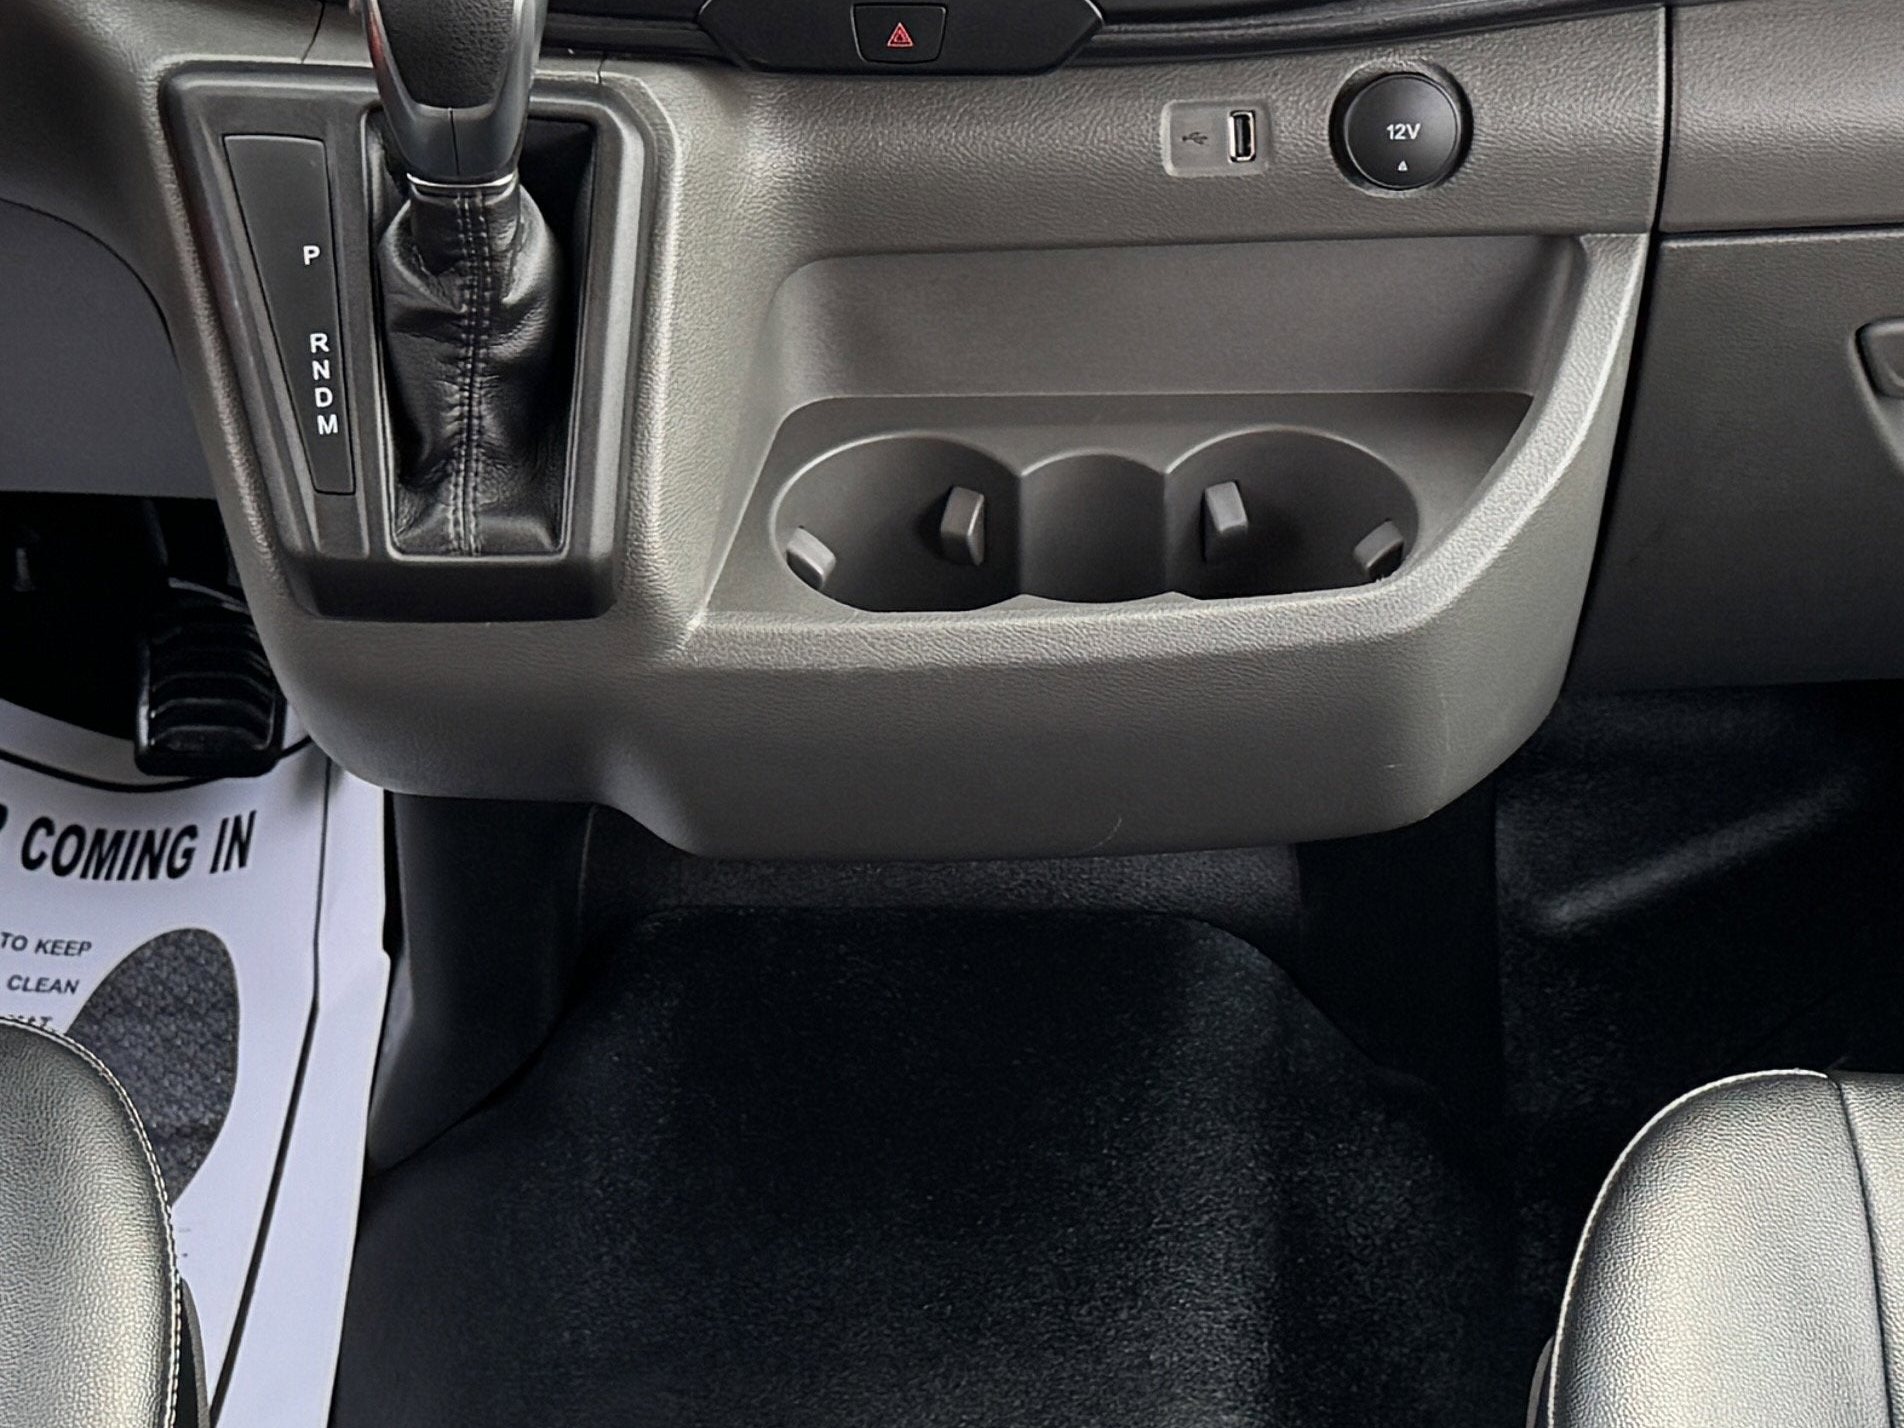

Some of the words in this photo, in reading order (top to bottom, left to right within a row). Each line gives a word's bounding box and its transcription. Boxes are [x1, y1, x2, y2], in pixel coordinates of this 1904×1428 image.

[1386, 122, 1421, 140] 12V
[303, 245, 320, 266] P
[310, 333, 330, 354] R
[312, 359, 331, 381] N
[314, 387, 333, 408] D
[316, 414, 339, 436] M
[20, 815, 198, 881] COMING
[210, 810, 257, 873] IN
[0, 931, 28, 952] TO
[33, 939, 92, 958] KEEP
[7, 974, 80, 995] CLEAN
